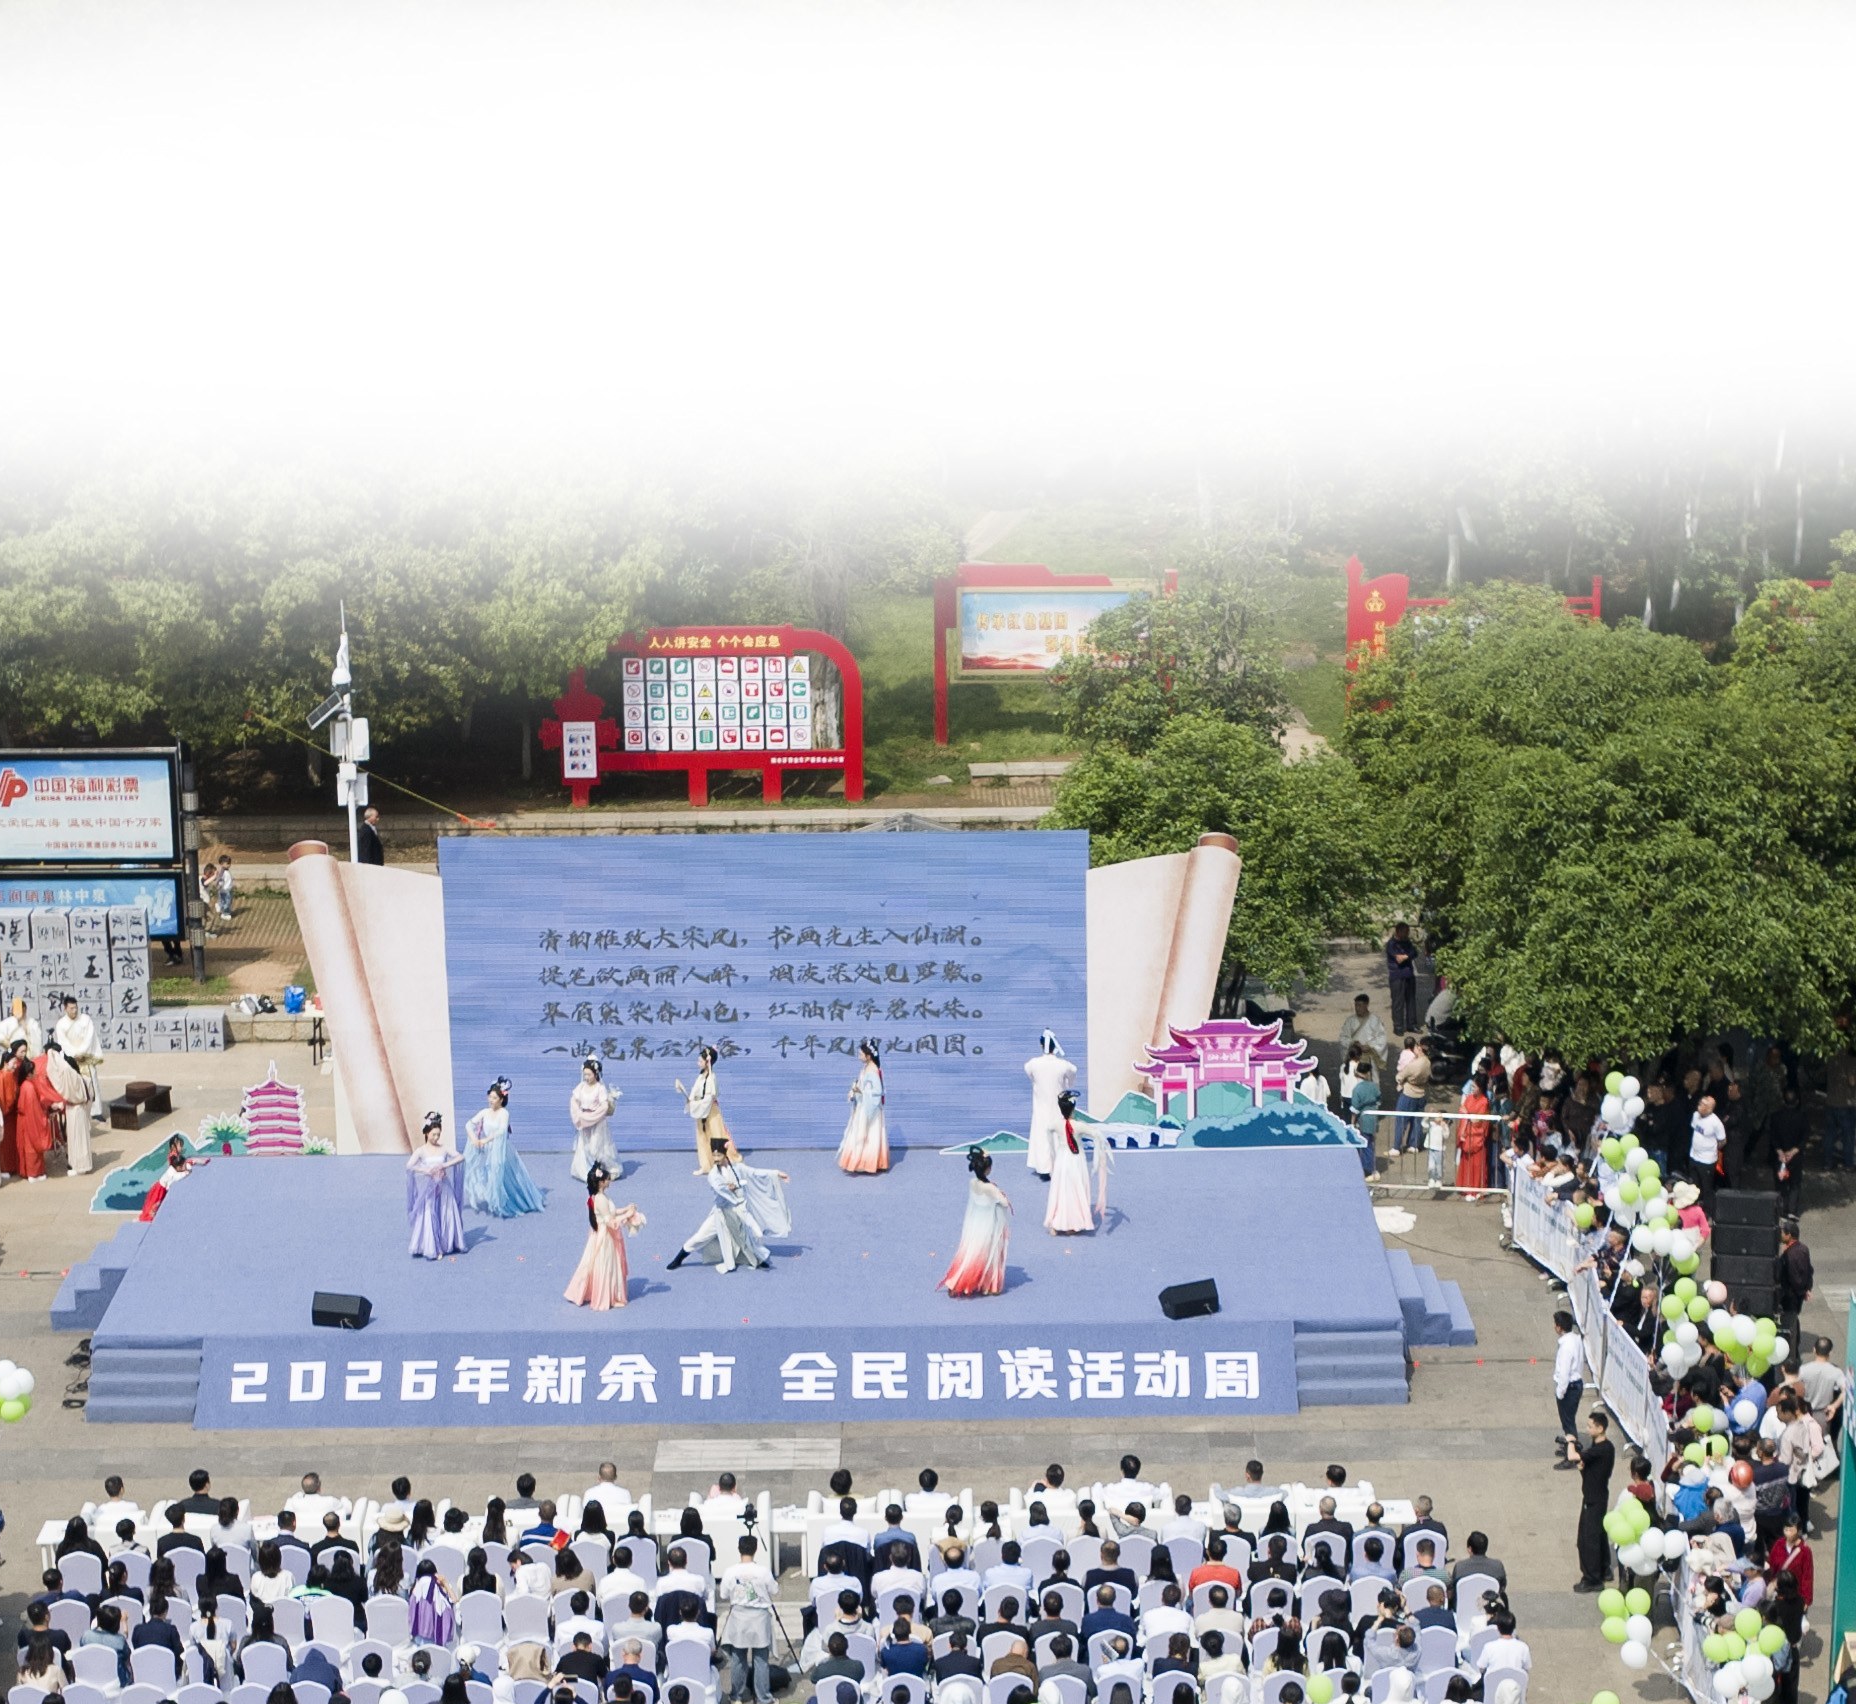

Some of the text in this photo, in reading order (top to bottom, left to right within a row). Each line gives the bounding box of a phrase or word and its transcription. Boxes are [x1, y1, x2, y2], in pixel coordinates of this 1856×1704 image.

[649, 635, 781, 649] 人人讲安全 个个会应急
[33, 777, 139, 793] 中国福利彩票
[230, 1347, 1260, 1404] 2026年新余市 全民阅读活动周
